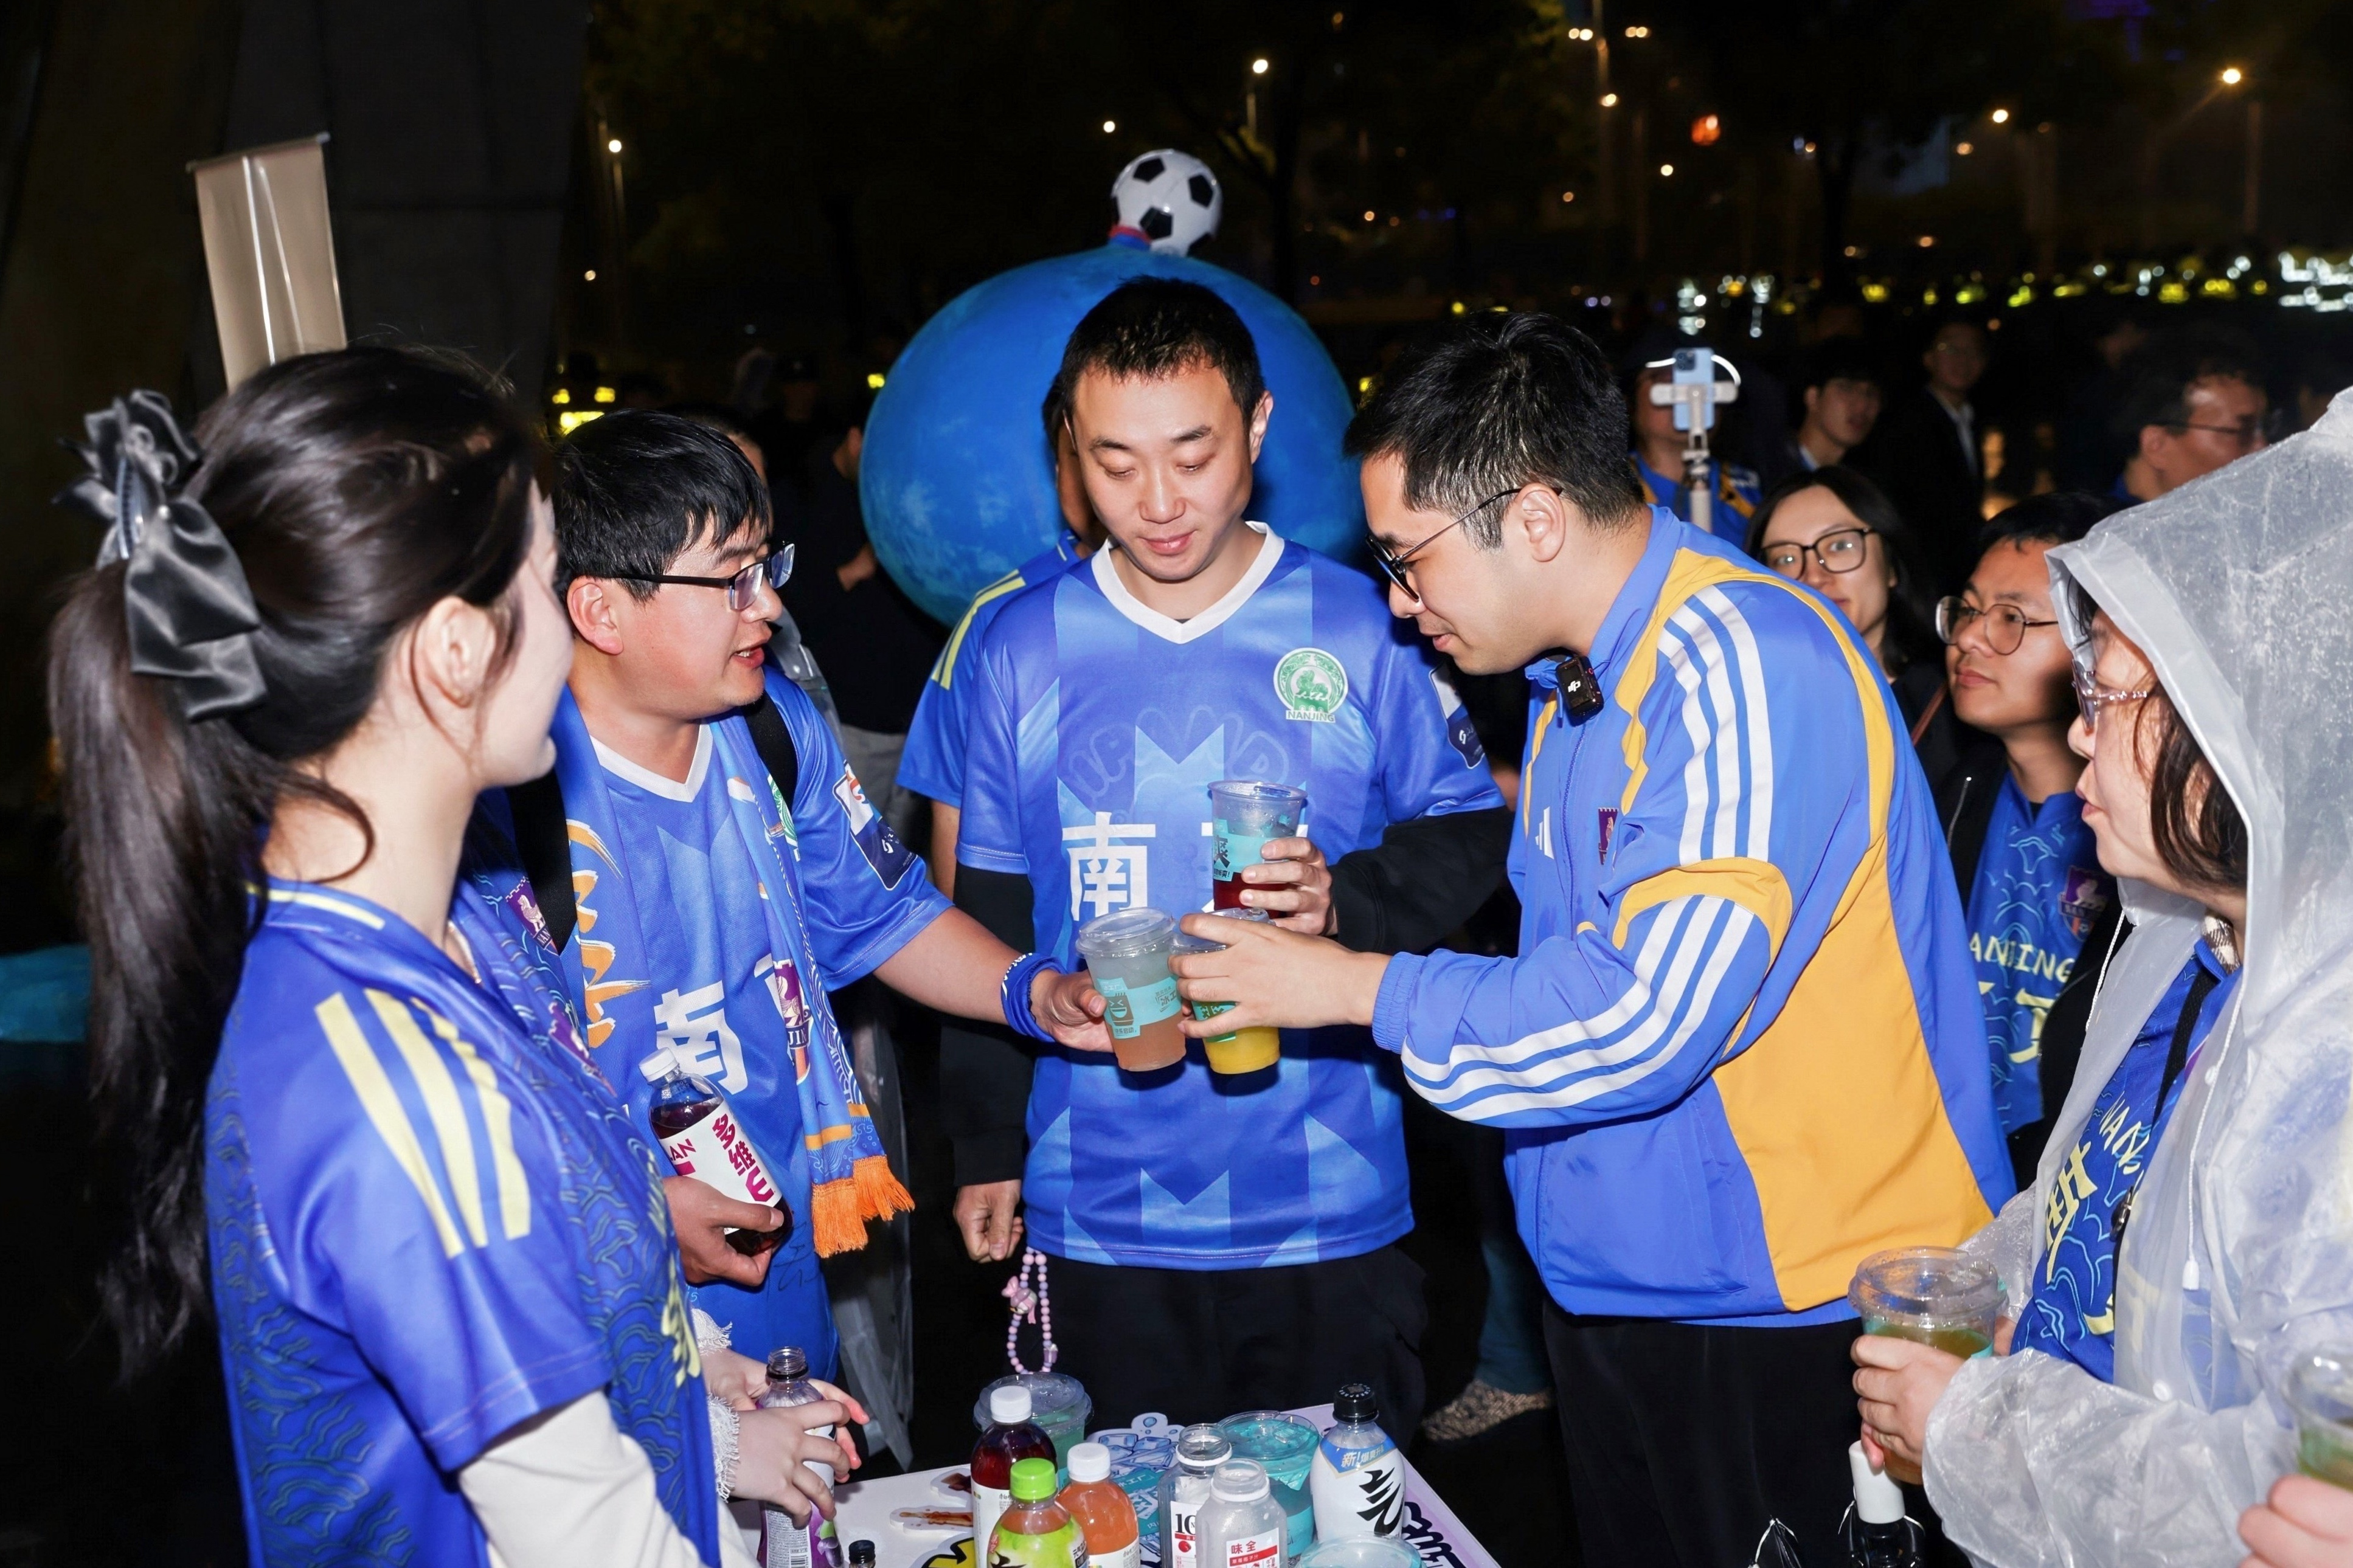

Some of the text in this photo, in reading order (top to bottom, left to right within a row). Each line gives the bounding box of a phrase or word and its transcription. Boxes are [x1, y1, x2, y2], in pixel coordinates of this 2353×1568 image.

[1287, 711, 1334, 722] NANJING
[537, 928, 550, 945] NAN
[1160, 990, 1177, 1006] 冰工
[788, 1029, 807, 1046] JIN
[670, 1138, 696, 1161] AN
[1231, 1541, 1256, 1555] 味全
